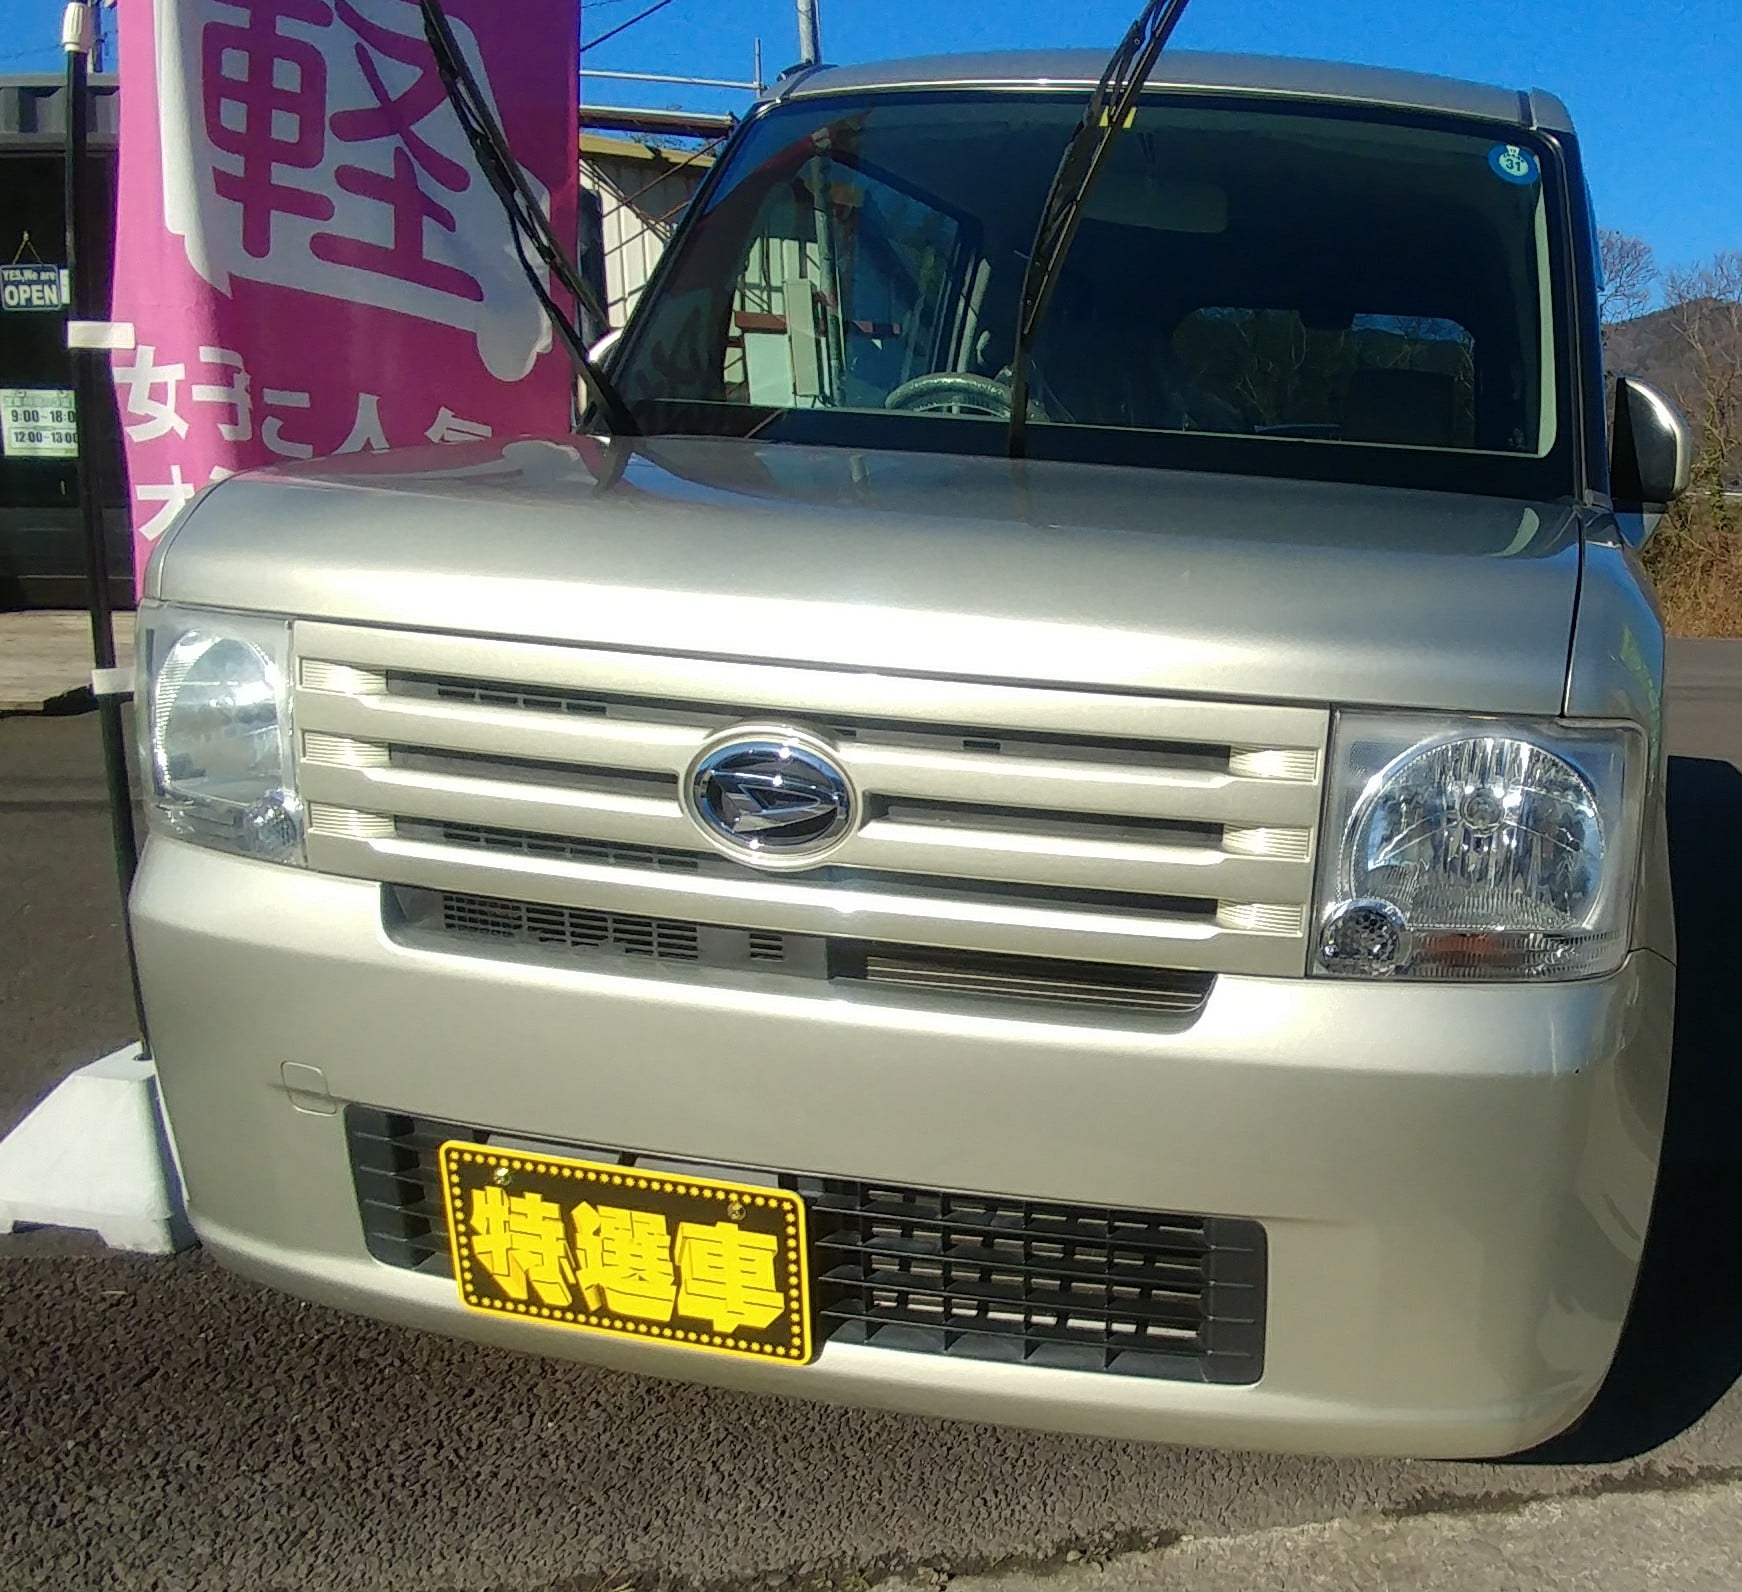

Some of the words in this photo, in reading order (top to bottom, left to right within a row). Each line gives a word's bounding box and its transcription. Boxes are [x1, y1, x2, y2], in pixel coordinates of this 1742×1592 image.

[202, 0, 485, 302] 軽
[1506, 158, 1521, 171] 31
[4, 284, 59, 306] OPEN
[470, 1185, 785, 1334] 特選車
